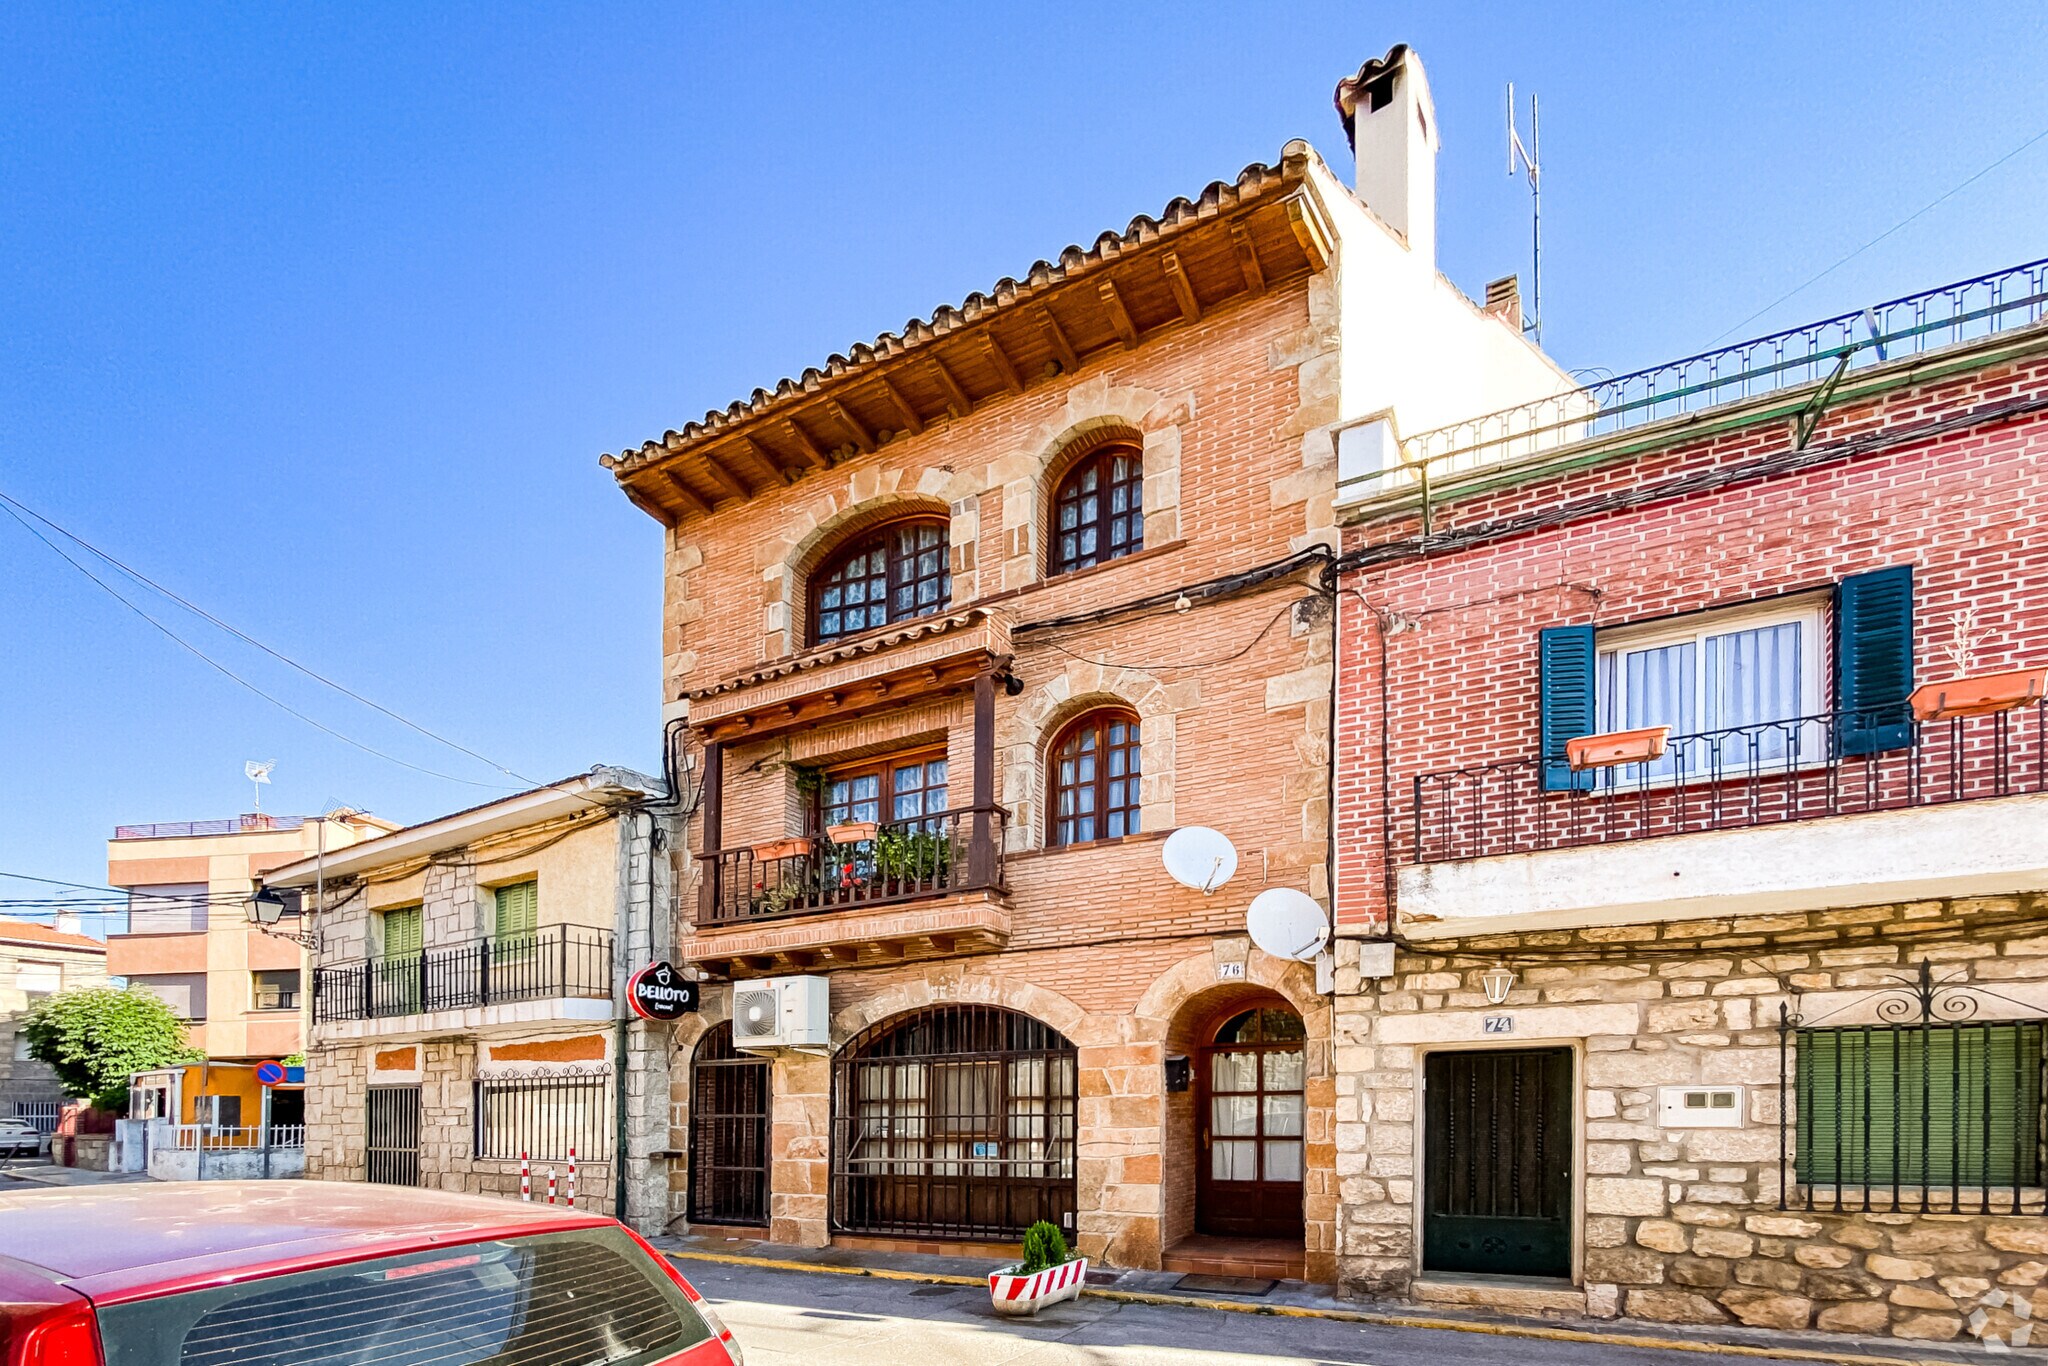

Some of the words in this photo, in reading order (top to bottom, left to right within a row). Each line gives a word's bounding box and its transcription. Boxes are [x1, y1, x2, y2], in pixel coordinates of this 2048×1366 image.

[1222, 964, 1240, 976] 76
[638, 983, 690, 1003] BELLOTO
[1486, 1017, 1511, 1032] 74
